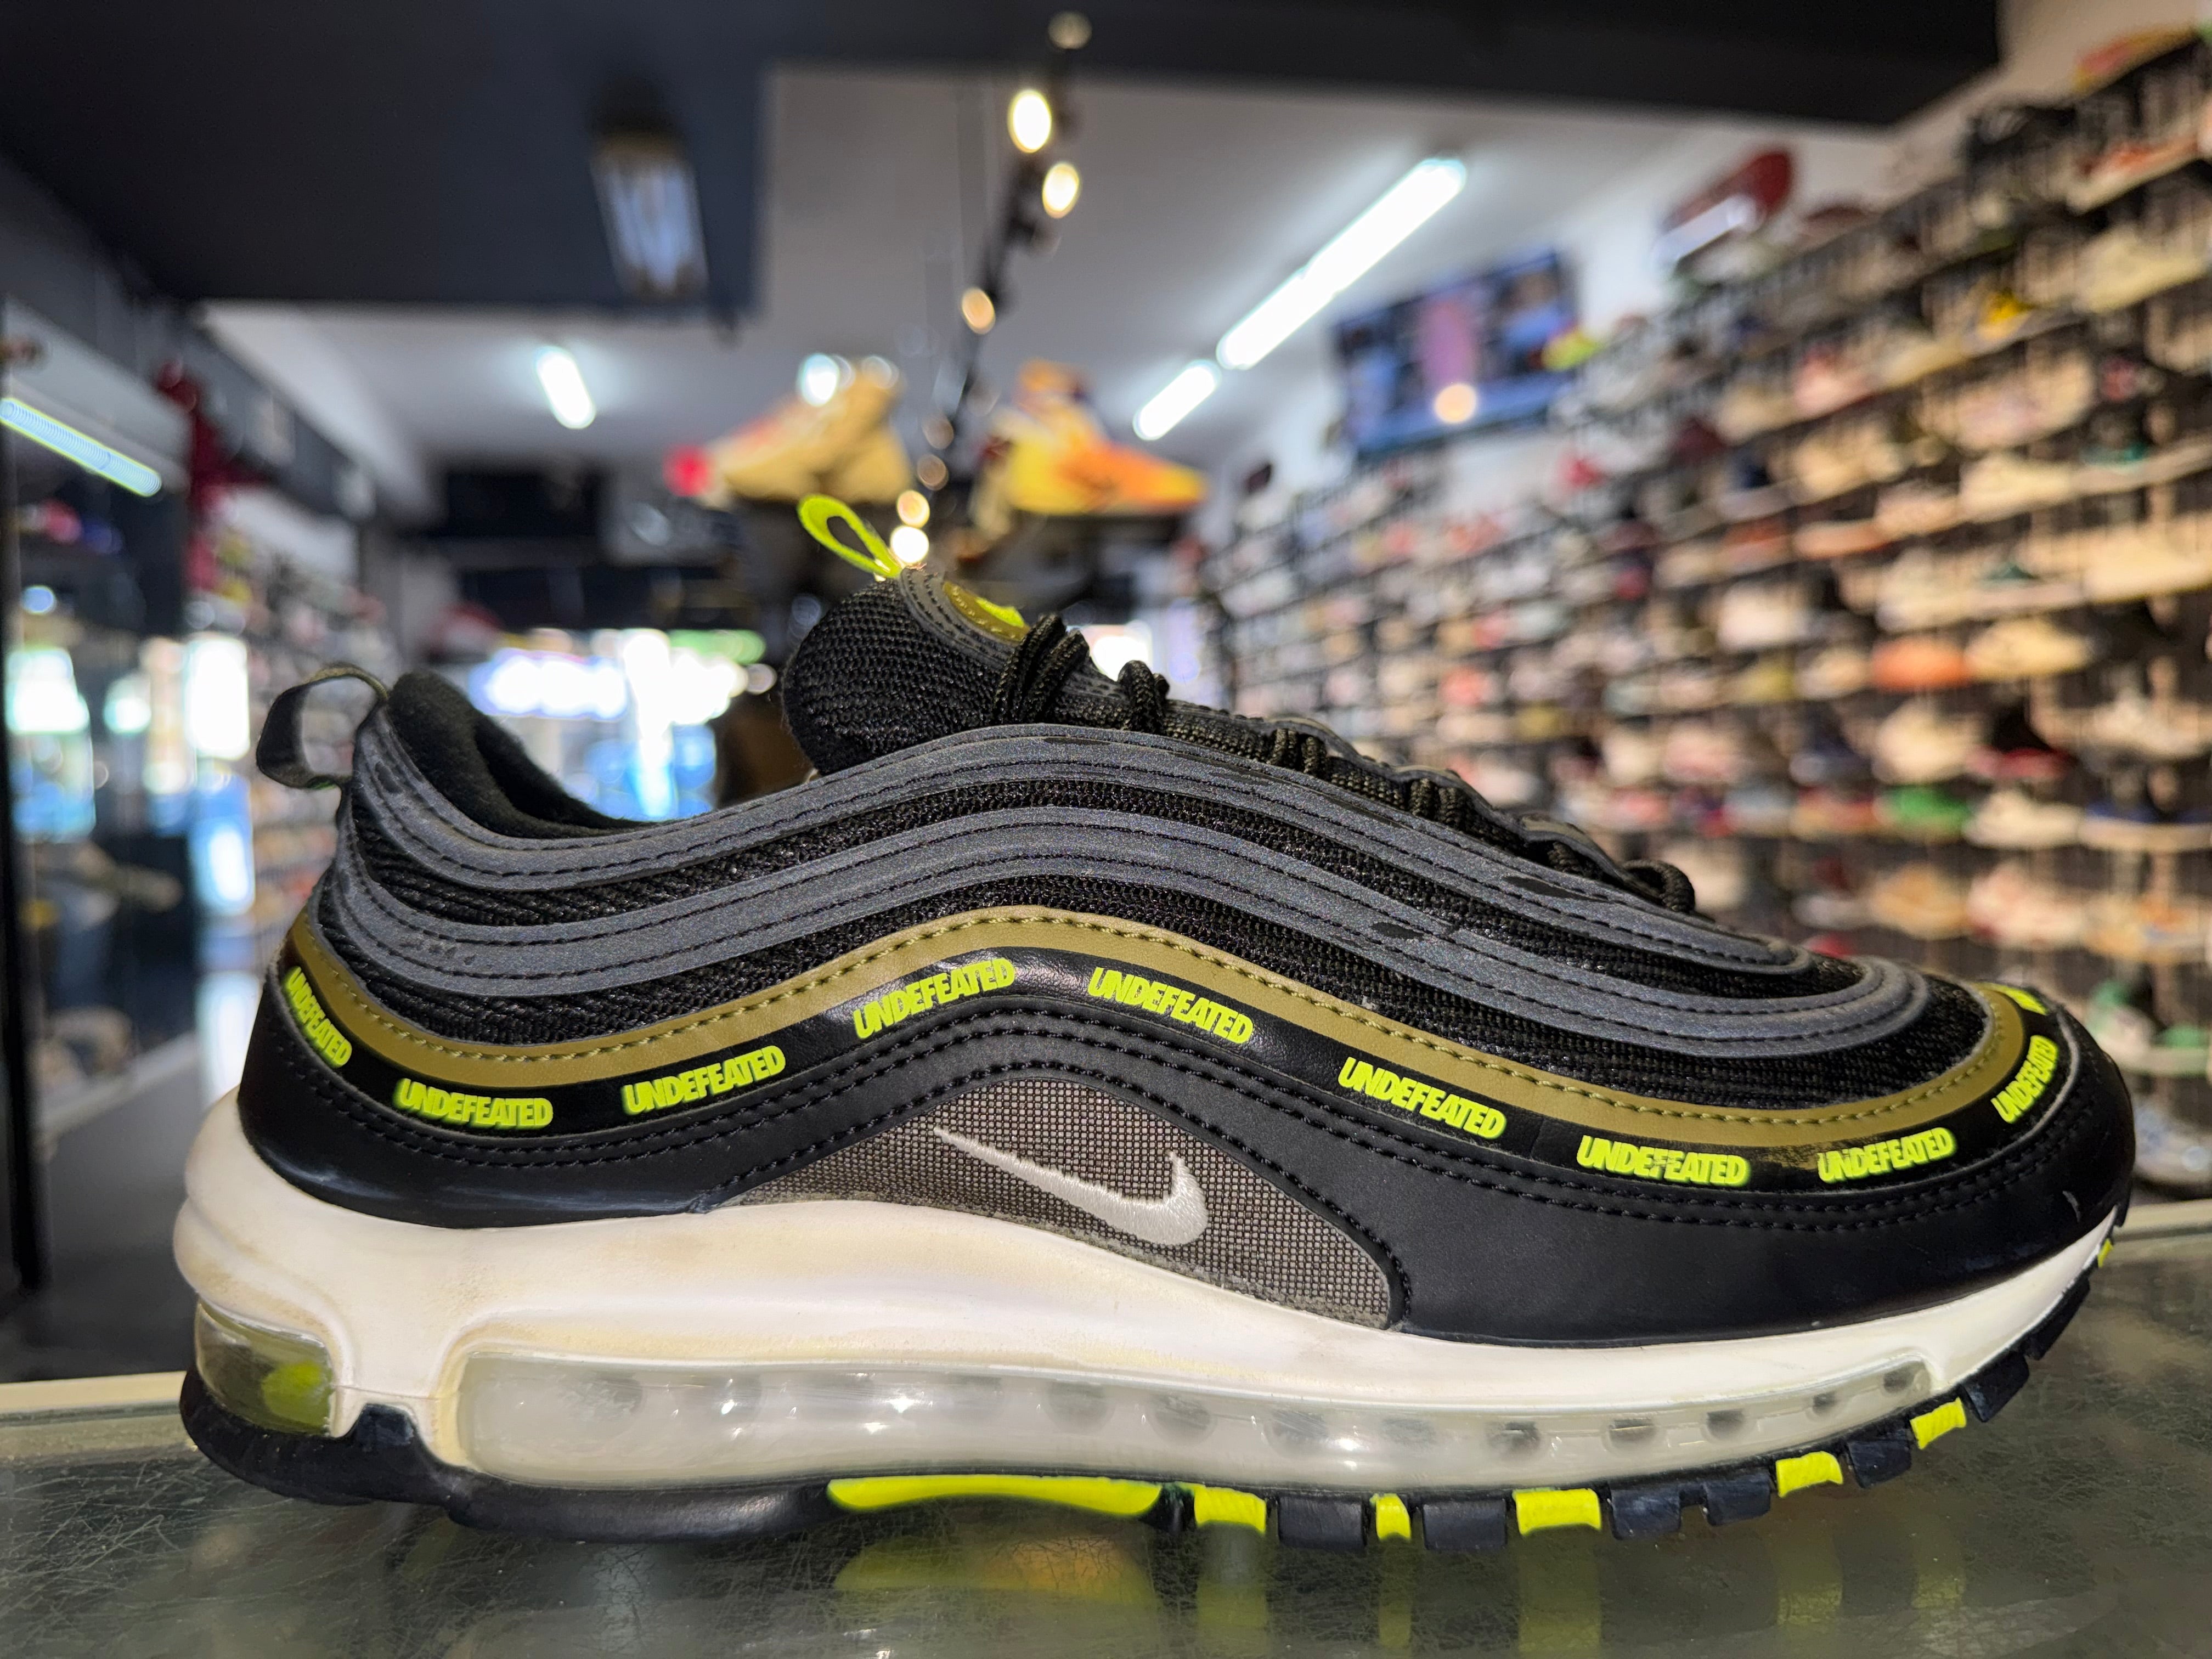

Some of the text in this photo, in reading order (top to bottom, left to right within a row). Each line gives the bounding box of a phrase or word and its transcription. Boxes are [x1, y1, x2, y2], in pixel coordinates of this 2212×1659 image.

[285, 967, 352, 1065] UNDEFEATED
[854, 960, 1014, 1037] UNDEFEATED
[1089, 968, 1252, 1042] UNDEFEATED
[396, 1079, 553, 1127] UNDEFEATED
[623, 1046, 786, 1114] UNDEFEATED
[1339, 1058, 1505, 1138] UNDEFEATED
[1991, 1035, 2058, 1123] UNDEFEATED
[1577, 1136, 1749, 1185] UNDEFEATED
[1816, 1128, 1954, 1182] UNDEFEATED
